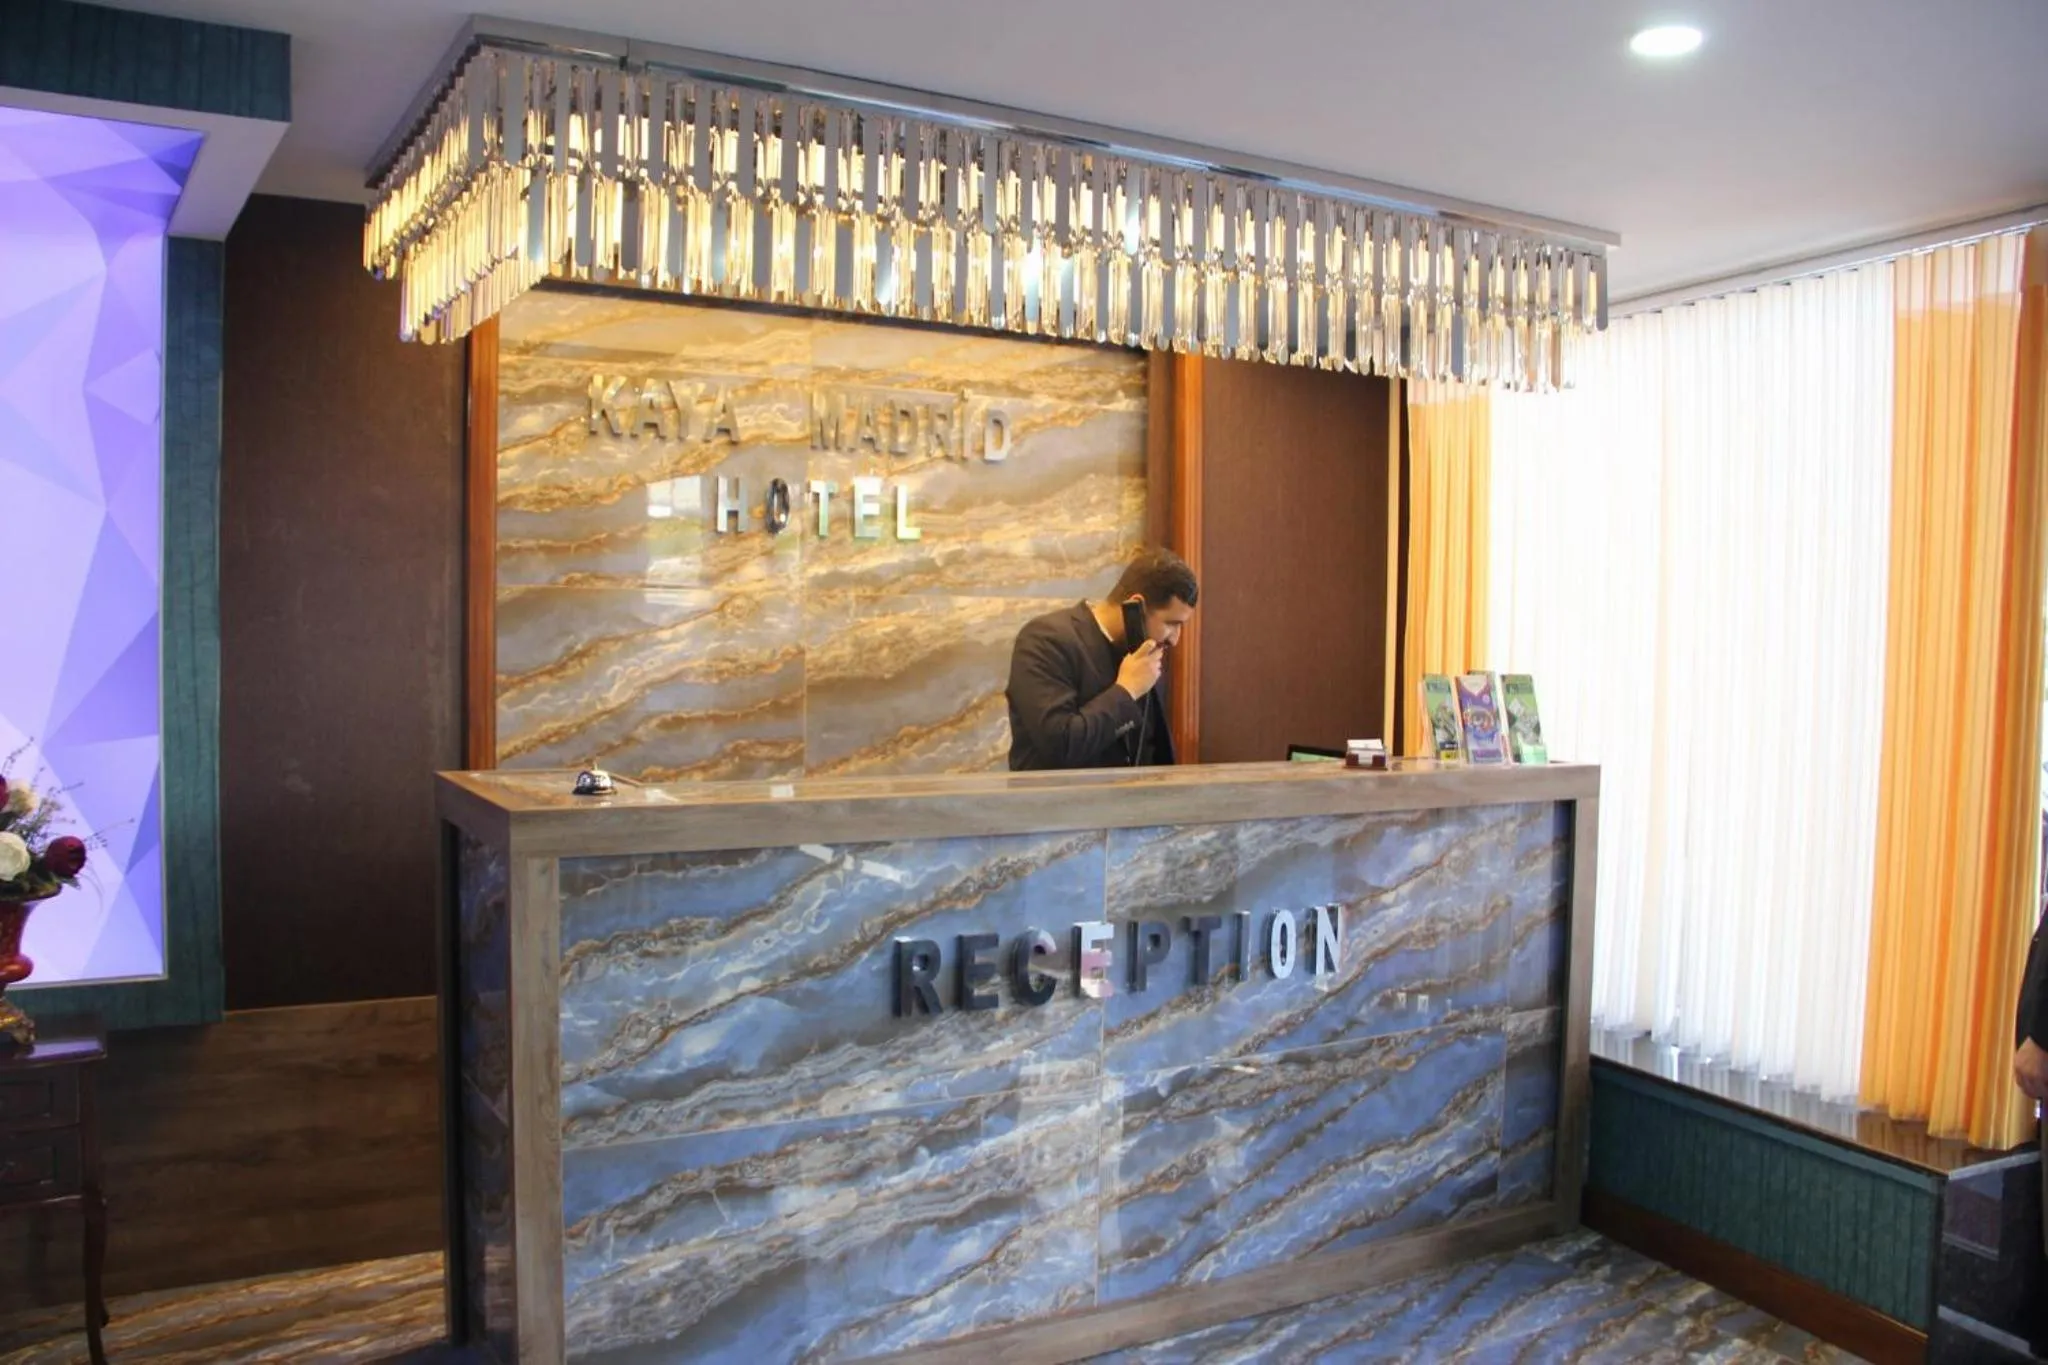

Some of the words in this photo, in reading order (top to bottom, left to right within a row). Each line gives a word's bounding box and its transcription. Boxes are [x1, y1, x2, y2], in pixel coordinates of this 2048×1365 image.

[588, 374, 740, 444] KAYA
[716, 475, 922, 540] HOTEL
[892, 903, 1344, 1018] RECEPTION
